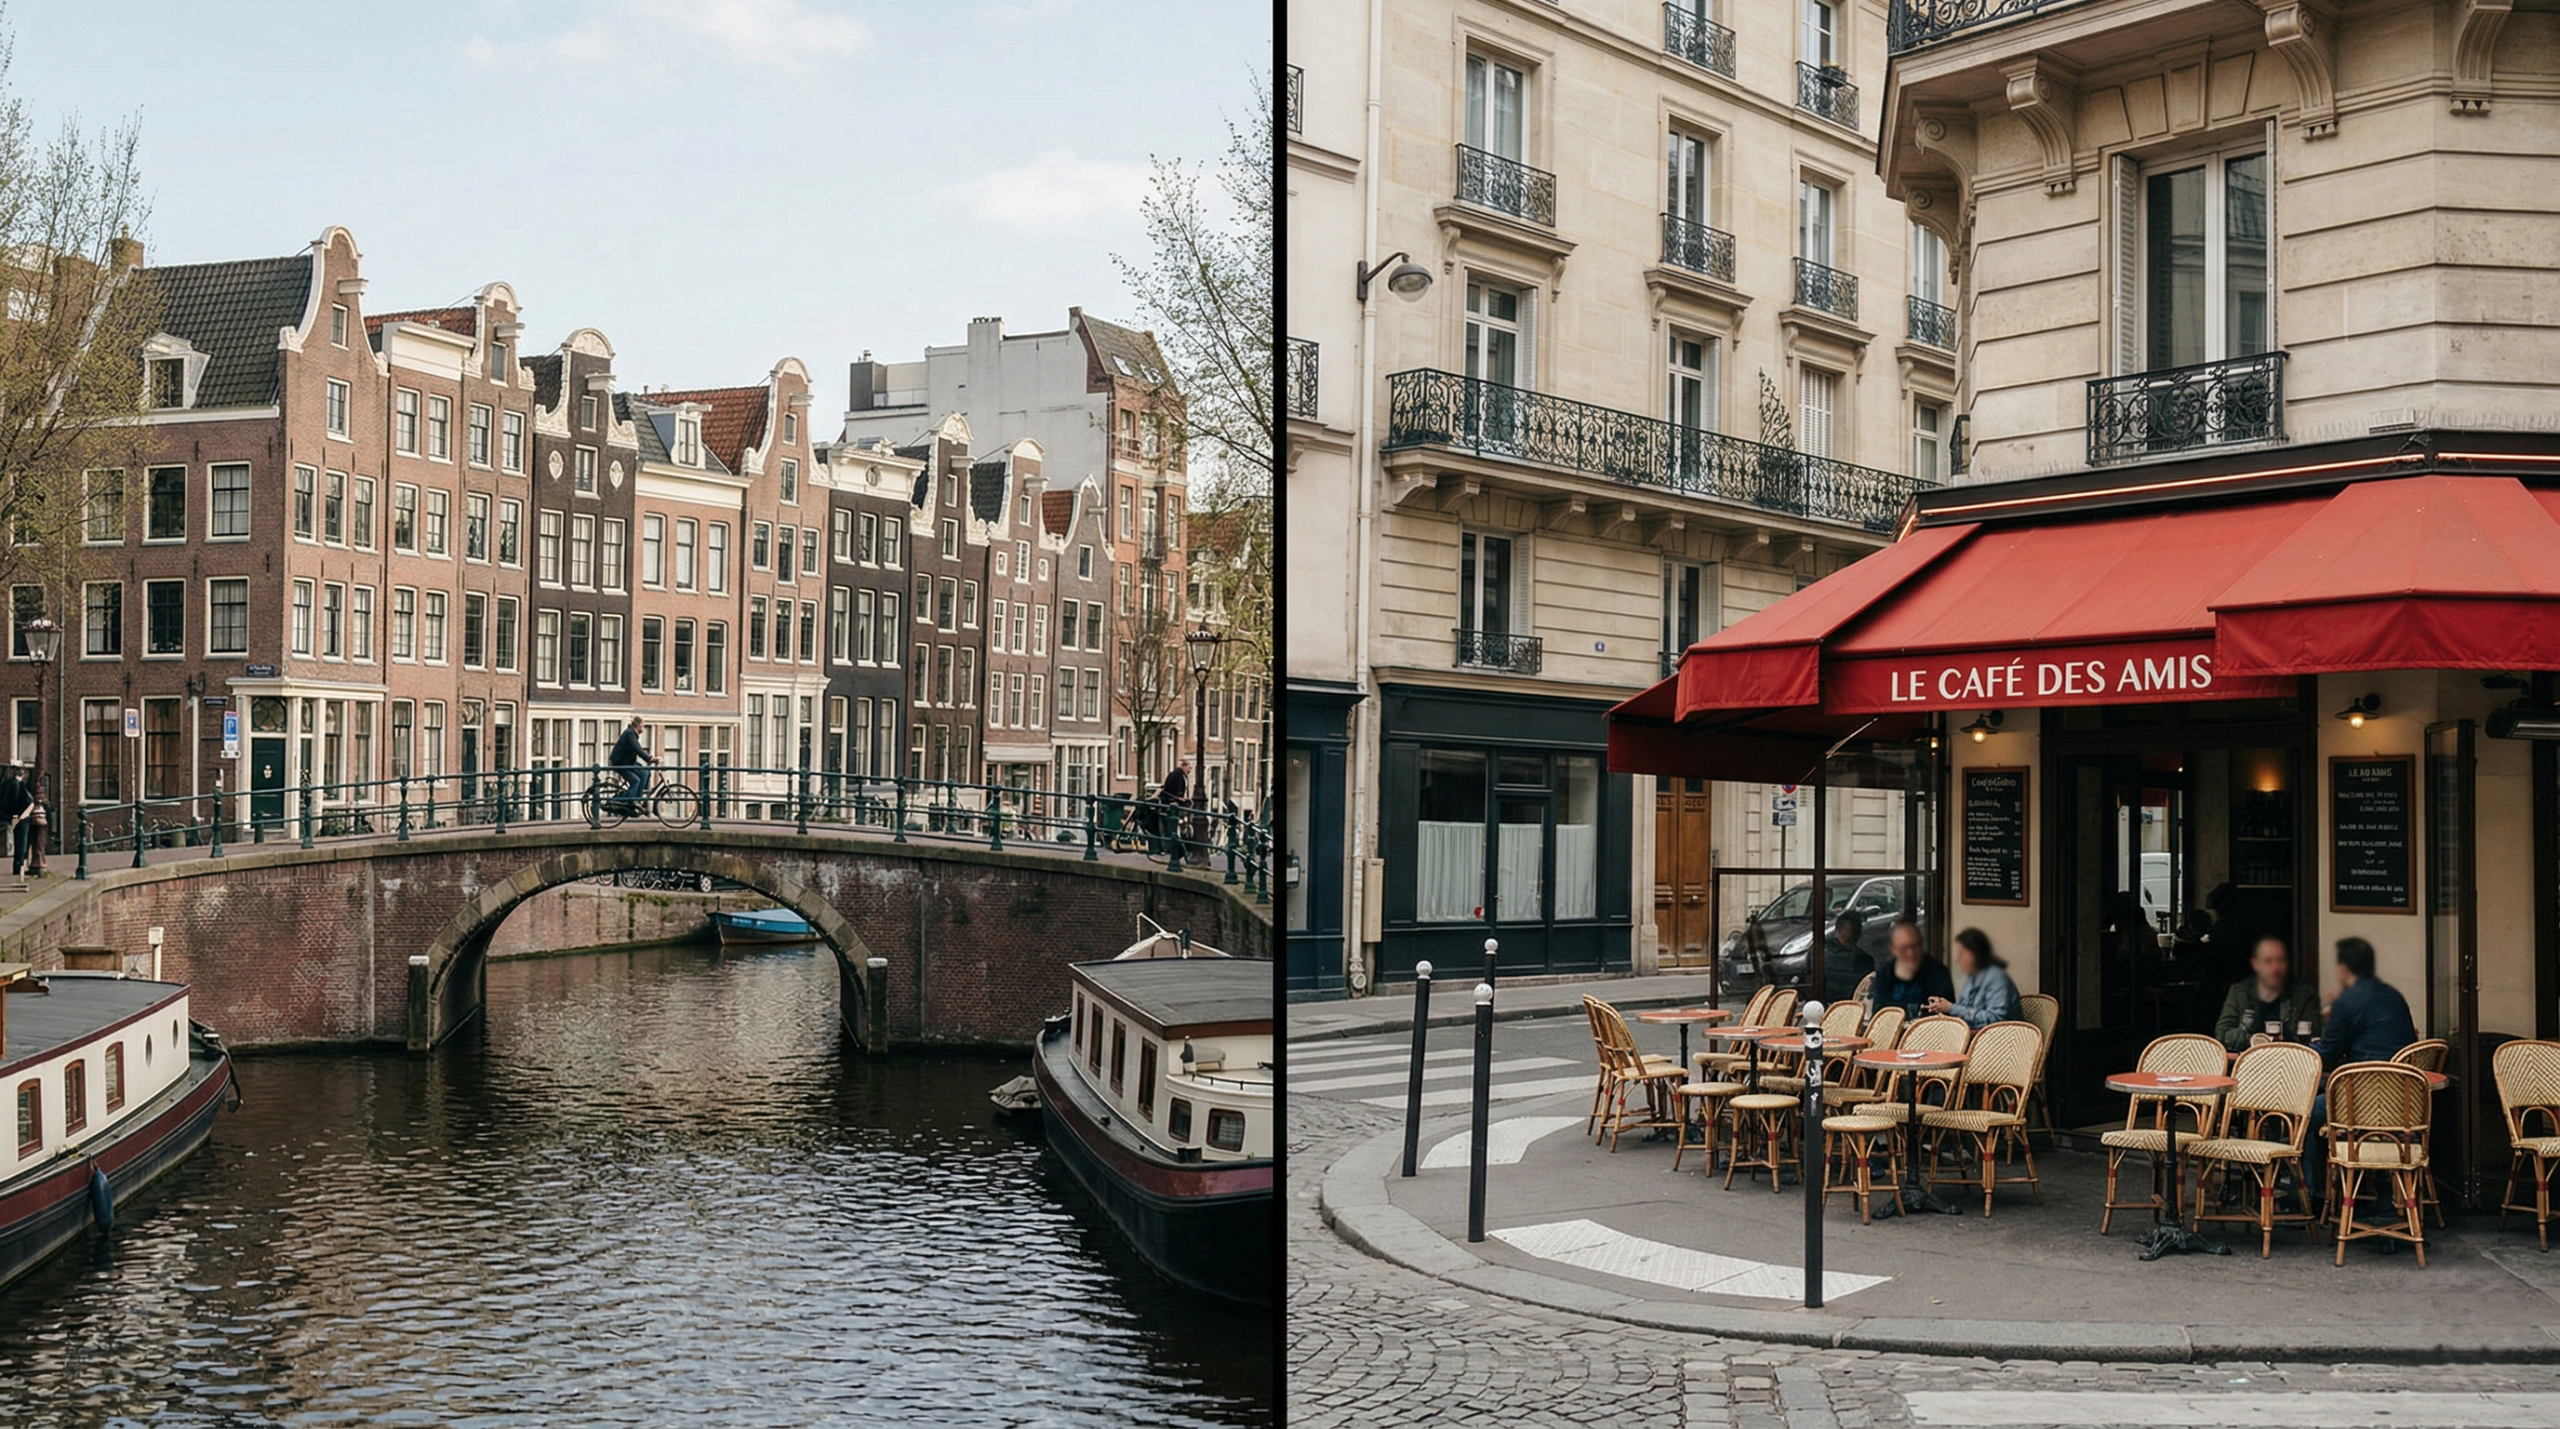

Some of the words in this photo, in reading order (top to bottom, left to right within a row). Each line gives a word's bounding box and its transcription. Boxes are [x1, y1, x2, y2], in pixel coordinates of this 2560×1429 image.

[1892, 670, 1927, 701] LE
[1938, 657, 2025, 700] CAFÉ
[2038, 660, 2106, 695] DES
[2116, 654, 2212, 692] AMIS
